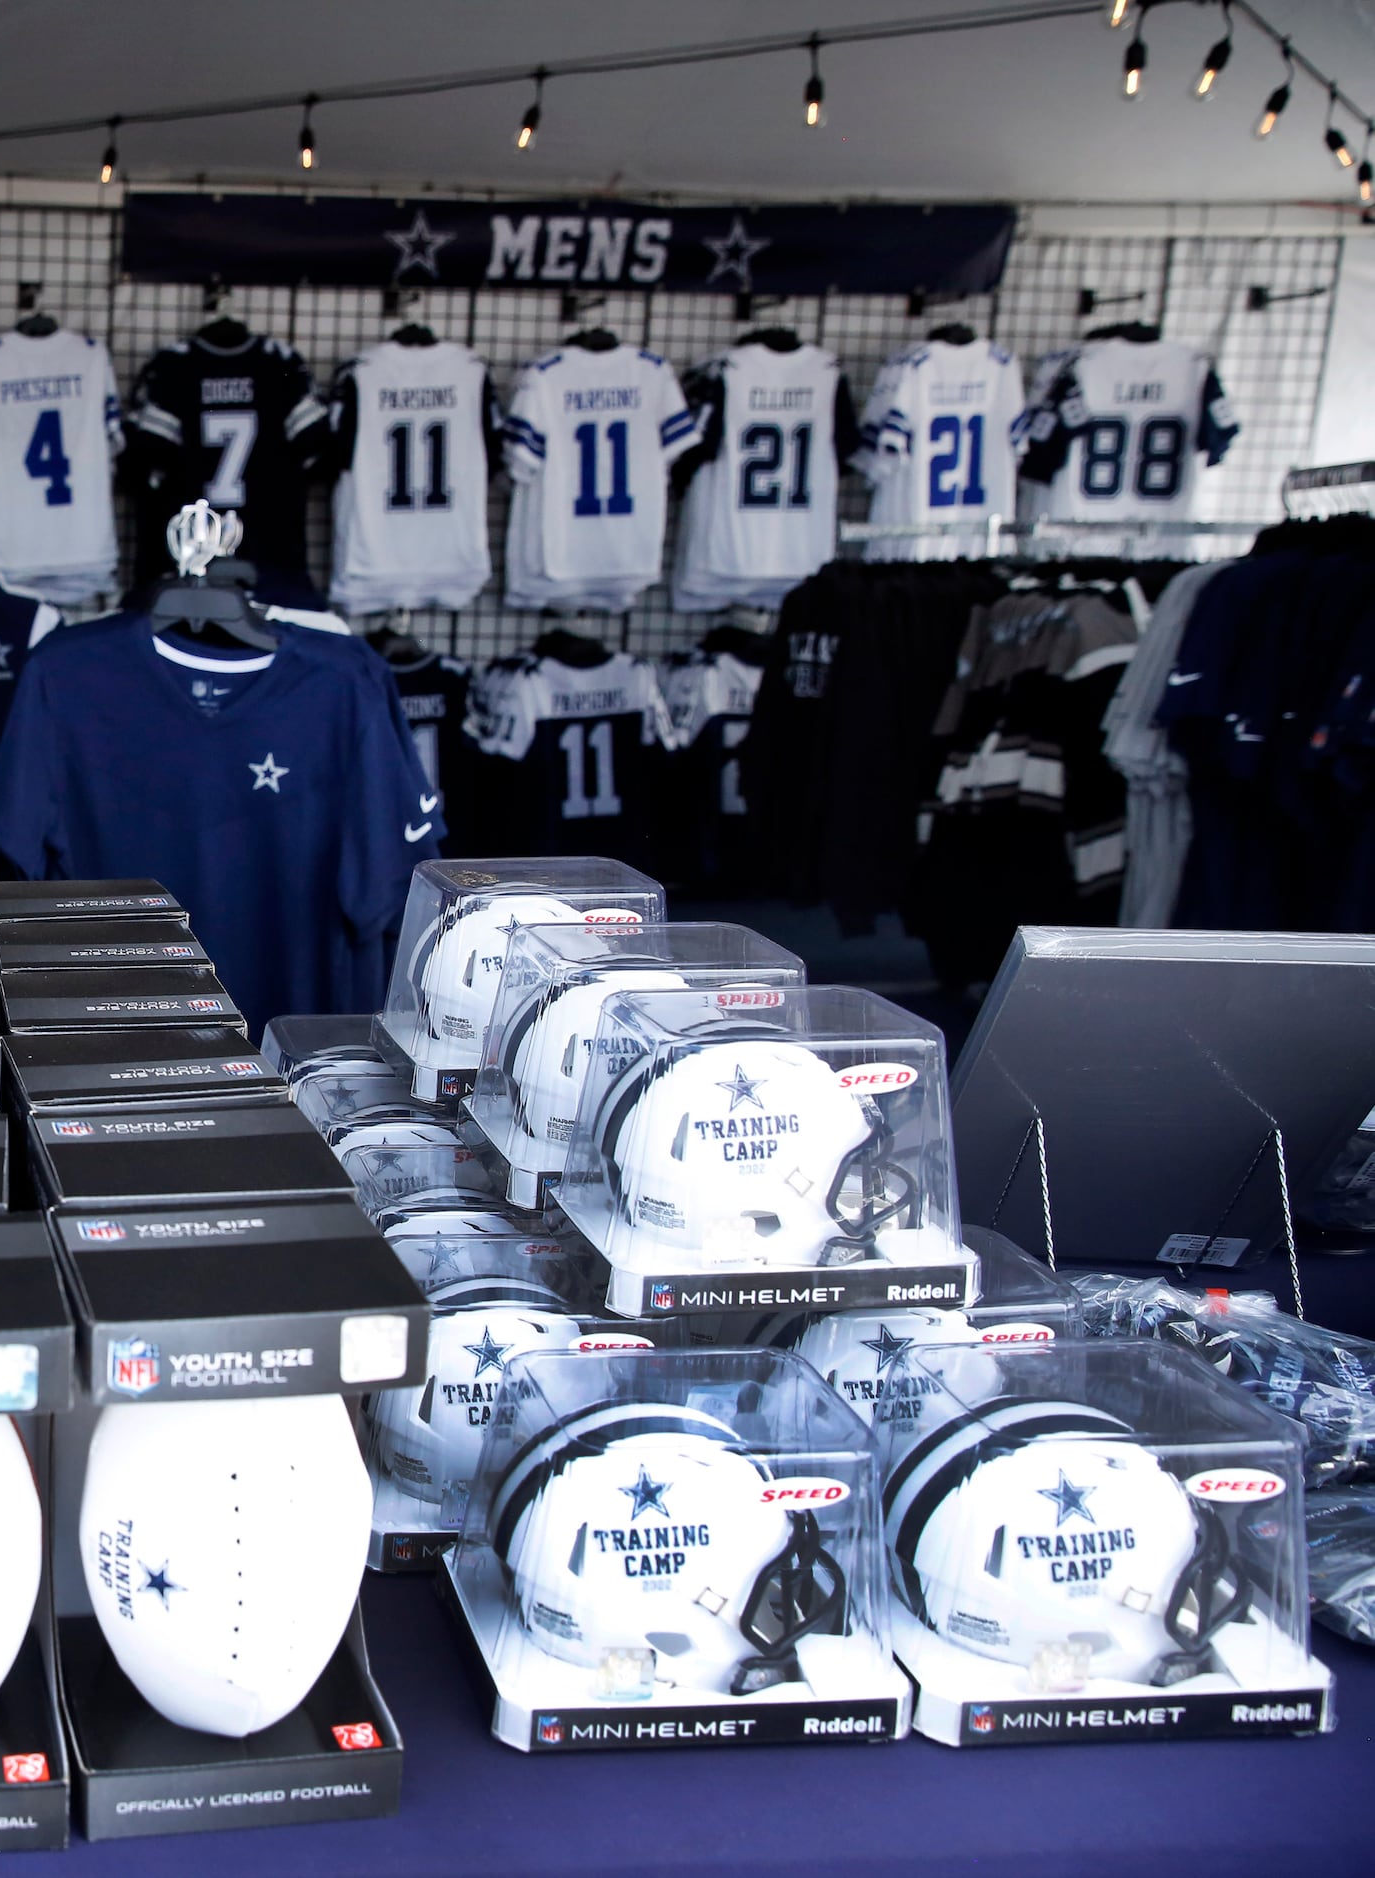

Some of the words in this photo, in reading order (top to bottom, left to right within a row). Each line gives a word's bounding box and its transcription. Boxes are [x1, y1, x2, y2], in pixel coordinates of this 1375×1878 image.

[487, 216, 673, 282] MENS
[0, 373, 83, 404] PRESCOTT
[379, 385, 457, 412] PARSONS
[564, 386, 640, 412] PARSONS
[24, 409, 73, 506] 4
[199, 410, 259, 507] 7
[384, 418, 454, 514] 11
[573, 420, 634, 517] 11
[737, 420, 814, 510] 21
[928, 414, 985, 507] 21
[1081, 413, 1186, 501] 88
[559, 721, 622, 819] 11
[716, 992, 780, 1007] SPEED
[109, 1072, 149, 1080] SIZE
[155, 1068, 217, 1077] YOUTH
[838, 1071, 911, 1088] SPEED
[101, 1122, 167, 1131] YOUTH
[173, 1119, 216, 1127] SIZE
[694, 1113, 799, 1140] TRAINING
[723, 1140, 778, 1162] CAMP
[133, 1221, 209, 1233] YOUTH
[216, 1218, 265, 1228] SIZE
[681, 1290, 733, 1307] MINI
[738, 1287, 846, 1305] HELMET
[169, 1352, 253, 1372] YOUTH
[260, 1348, 314, 1368] SIZE
[171, 1368, 288, 1387] FOOTBALL
[760, 1486, 844, 1503] SPEED
[1197, 1479, 1278, 1494] SPEED
[593, 1524, 710, 1553] TRAINING
[1017, 1528, 1136, 1558] TRAINING
[98, 1531, 114, 1589] CAMP
[115, 1519, 134, 1621] TRAINING
[624, 1552, 686, 1577] CAMP
[1051, 1558, 1113, 1583] CAMP
[571, 1722, 630, 1740] MINI
[637, 1719, 757, 1738] HELMET
[1002, 1711, 1060, 1730] MINI
[1065, 1706, 1187, 1727] HELMET
[115, 1796, 205, 1814] OFFICIALLY
[210, 1790, 286, 1807] LICENSED
[290, 1782, 371, 1800] FOOTBALL
